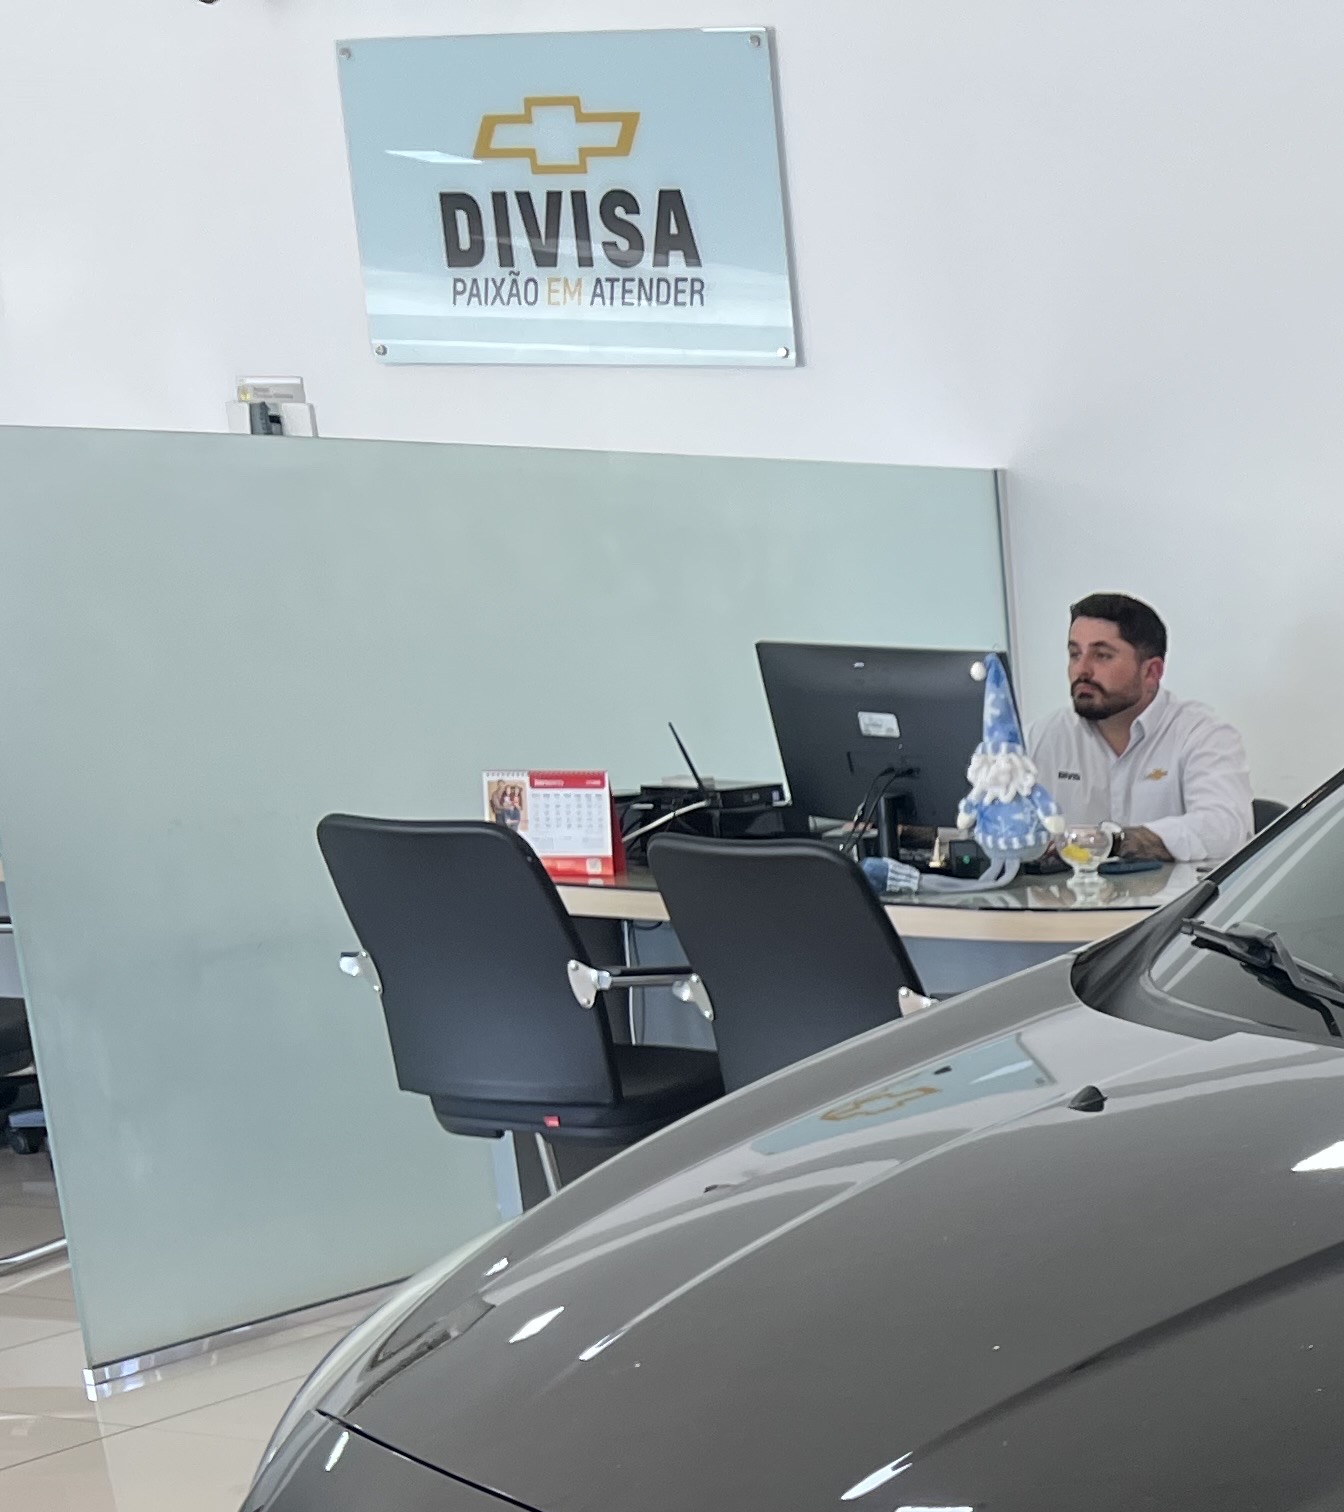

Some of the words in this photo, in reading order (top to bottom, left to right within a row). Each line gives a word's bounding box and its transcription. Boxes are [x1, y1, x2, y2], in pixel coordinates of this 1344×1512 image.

[438, 188, 703, 269] DIVISA
[452, 271, 539, 307] PAIXÃO
[546, 276, 583, 307] EM
[590, 276, 706, 308] ATENDER
